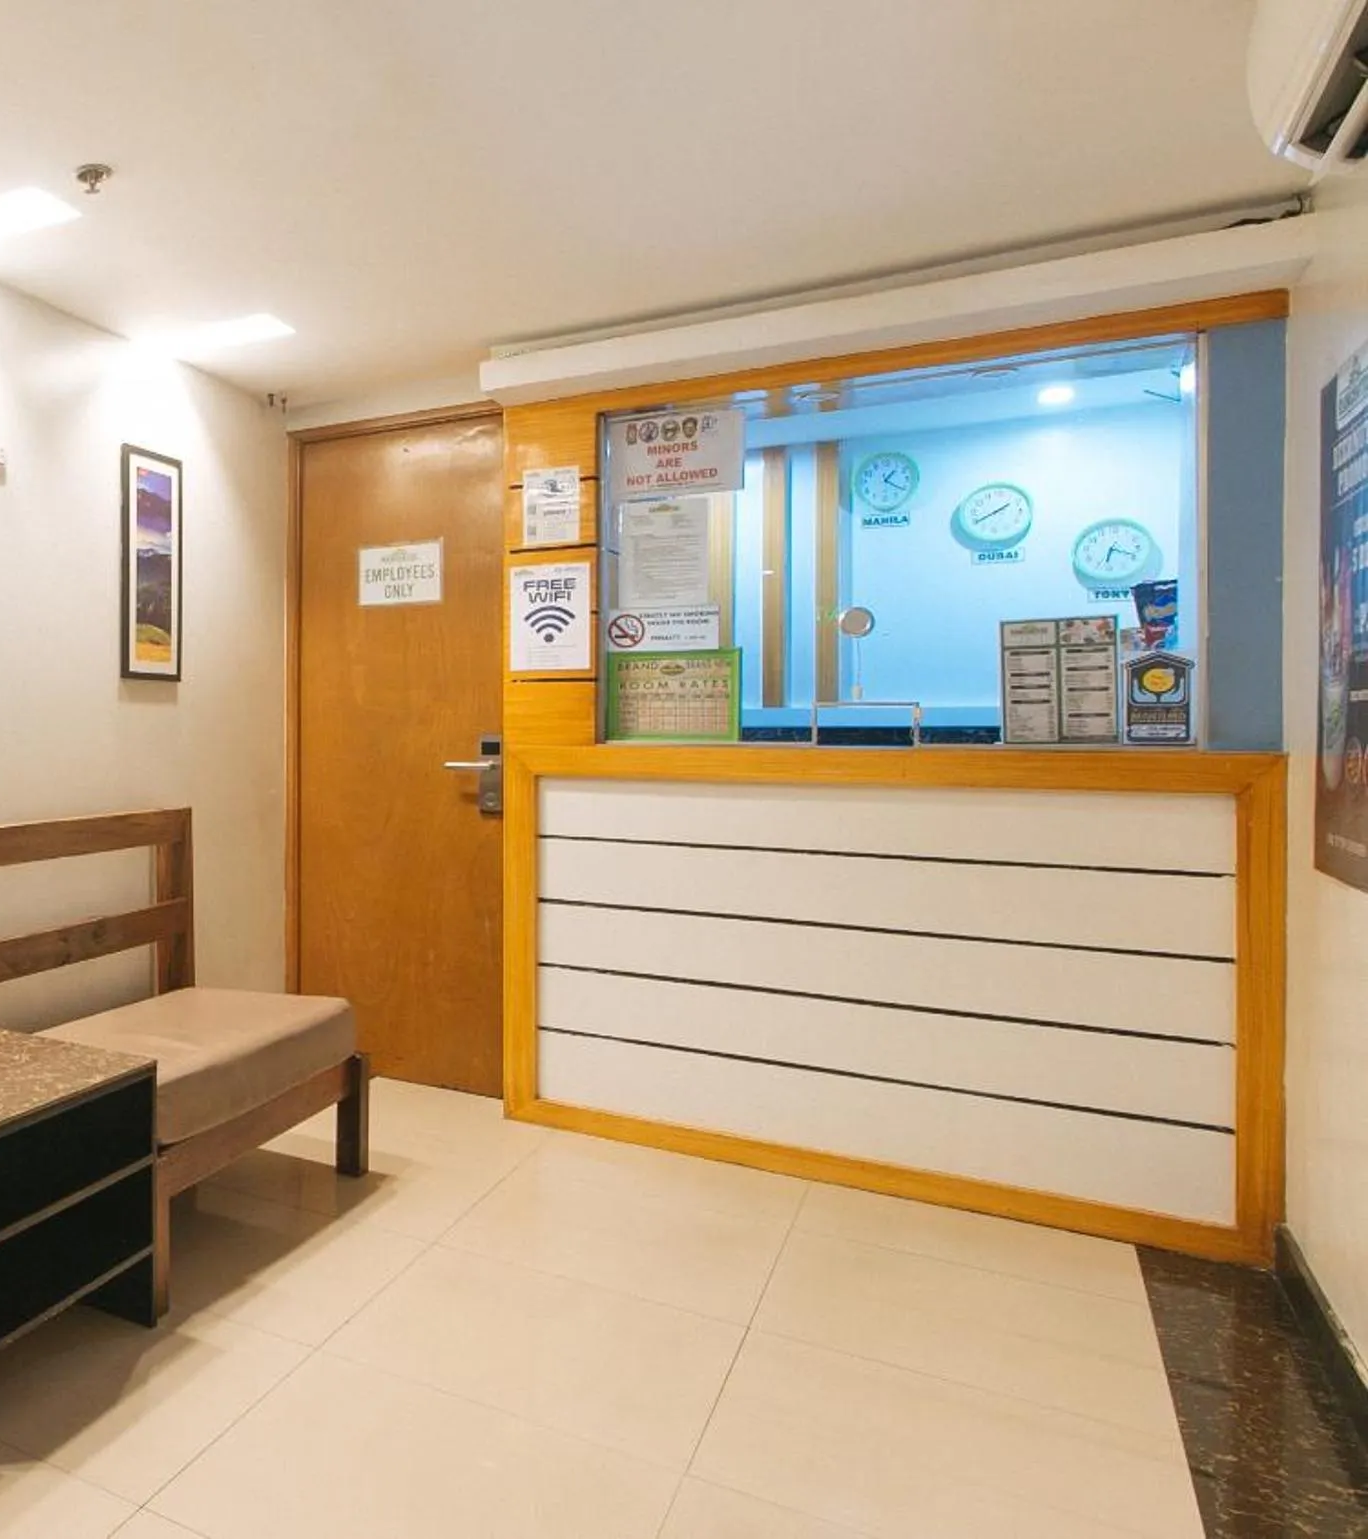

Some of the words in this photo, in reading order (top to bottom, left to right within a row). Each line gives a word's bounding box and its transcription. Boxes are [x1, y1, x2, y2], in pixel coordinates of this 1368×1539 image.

[647, 441, 698, 456] MINORS
[656, 458, 683, 468] ARE
[626, 475, 652, 486] NOT
[656, 468, 718, 483] ALLOWED
[863, 516, 908, 525] MANILA
[978, 551, 1018, 560] DUBAI
[365, 563, 435, 584] EMPLOYEES
[384, 583, 415, 599] ONLY
[523, 578, 577, 592] FREE
[529, 590, 572, 604] WIFI
[1095, 590, 1130, 599] TOKY
[619, 681, 668, 690] ROOM
[679, 679, 728, 689] RATES
